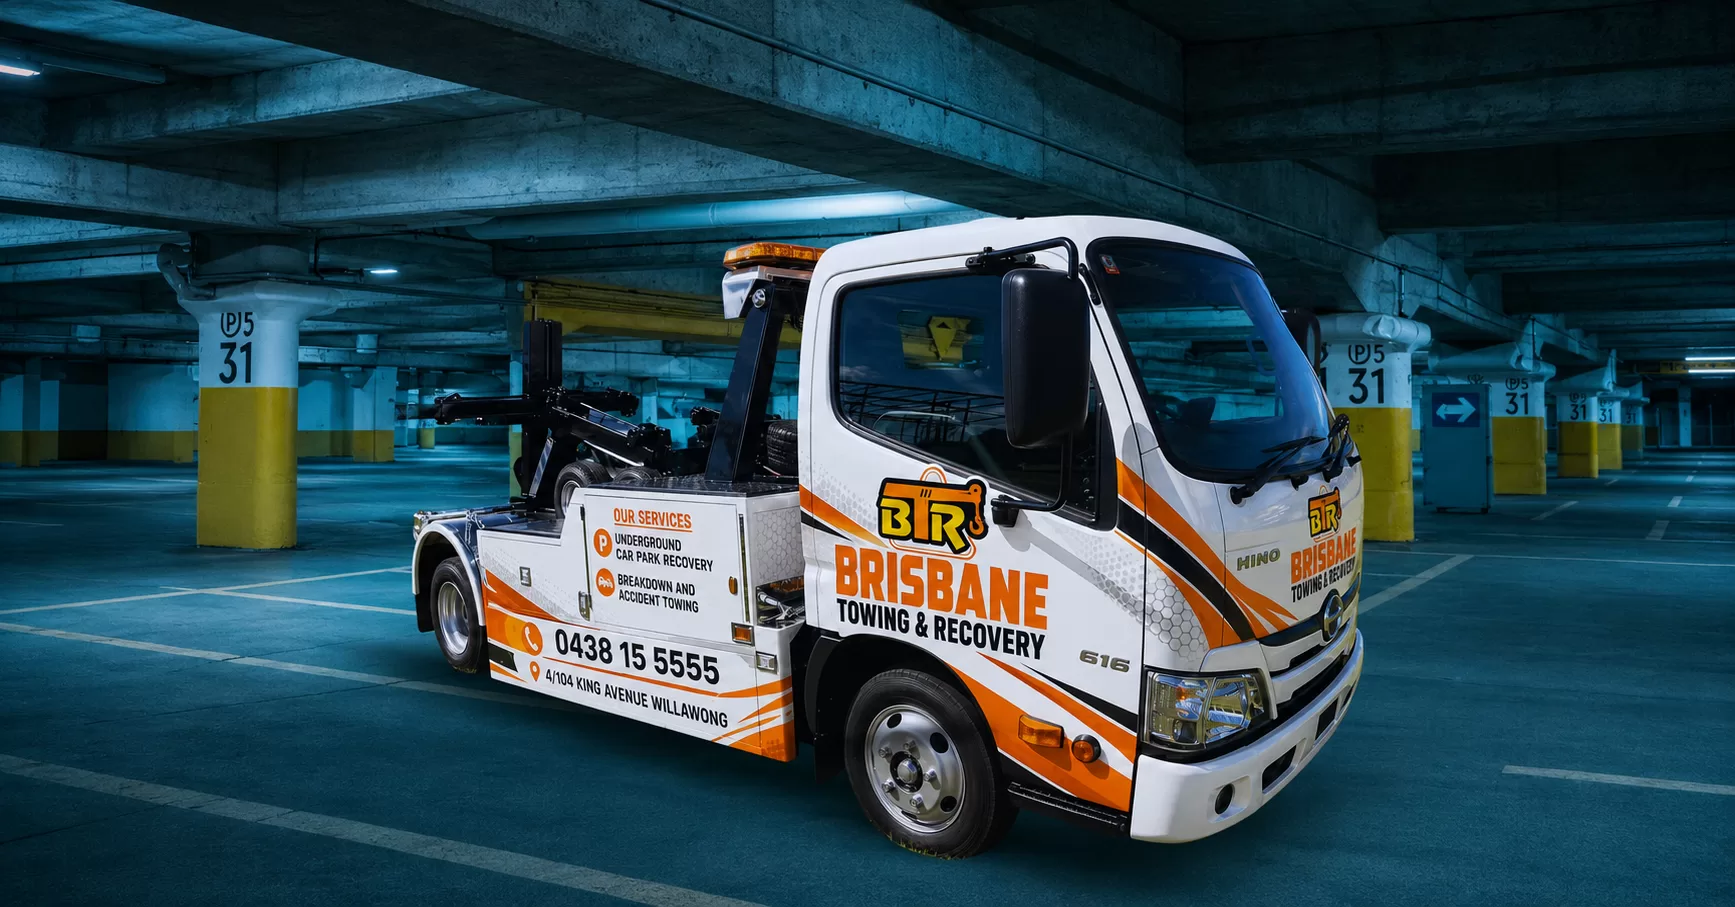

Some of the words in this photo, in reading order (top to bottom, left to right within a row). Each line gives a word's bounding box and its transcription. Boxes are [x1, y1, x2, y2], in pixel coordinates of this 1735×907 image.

[219, 341, 252, 384] 31
[1348, 367, 1385, 405] 31
[1505, 392, 1529, 415] 31
[1570, 403, 1587, 421] 31
[1599, 408, 1613, 423] 31
[613, 507, 636, 525] OUR
[638, 510, 692, 530] SERVICES
[880, 482, 974, 552] BTR
[1309, 490, 1341, 535] BTR
[614, 532, 682, 552] UNDERGROUND
[1291, 526, 1357, 585] BRISBANE
[615, 549, 634, 563] CAR
[636, 552, 661, 566] PARK
[663, 554, 714, 573] RECOVERY
[1237, 547, 1281, 571] HINO
[617, 573, 674, 594] BREAKDOWN
[675, 582, 696, 597] AND
[834, 543, 1049, 630] BRISBANE
[1290, 574, 1322, 603] TOWING
[1328, 556, 1356, 584] RECOVERY
[618, 588, 660, 608] ACCIDENT
[662, 595, 699, 613] TOWING
[836, 598, 910, 633] TOWING
[915, 612, 929, 638] &
[934, 615, 1046, 660] RECOVERY
[554, 628, 613, 665] 0438
[619, 640, 647, 671] 15
[653, 647, 721, 686] 5555
[1079, 649, 1130, 673] 616
[545, 668, 574, 689] 4/104
[576, 675, 601, 697] KING
[604, 680, 649, 709] AVENUE
[651, 695, 729, 729] WILLAWONG
